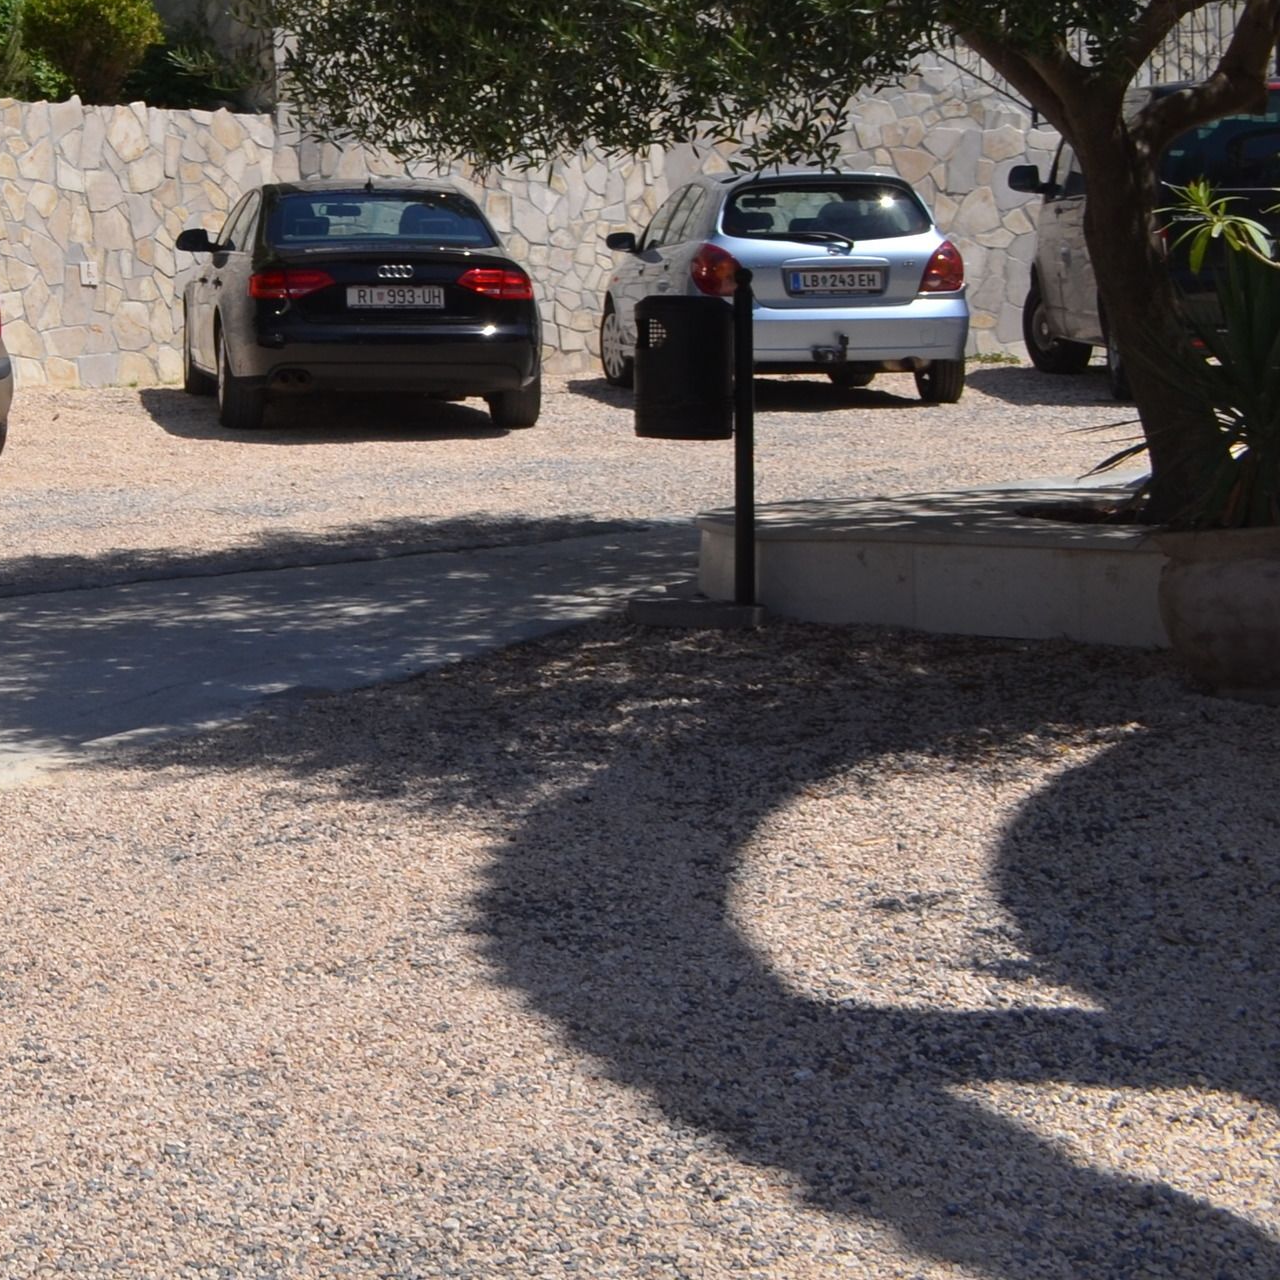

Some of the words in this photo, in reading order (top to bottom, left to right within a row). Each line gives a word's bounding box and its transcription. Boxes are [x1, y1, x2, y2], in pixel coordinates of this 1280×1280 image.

[803, 274, 820, 288] LB
[830, 274, 856, 288] 243
[858, 273, 876, 287] EH
[358, 288, 374, 304] RI
